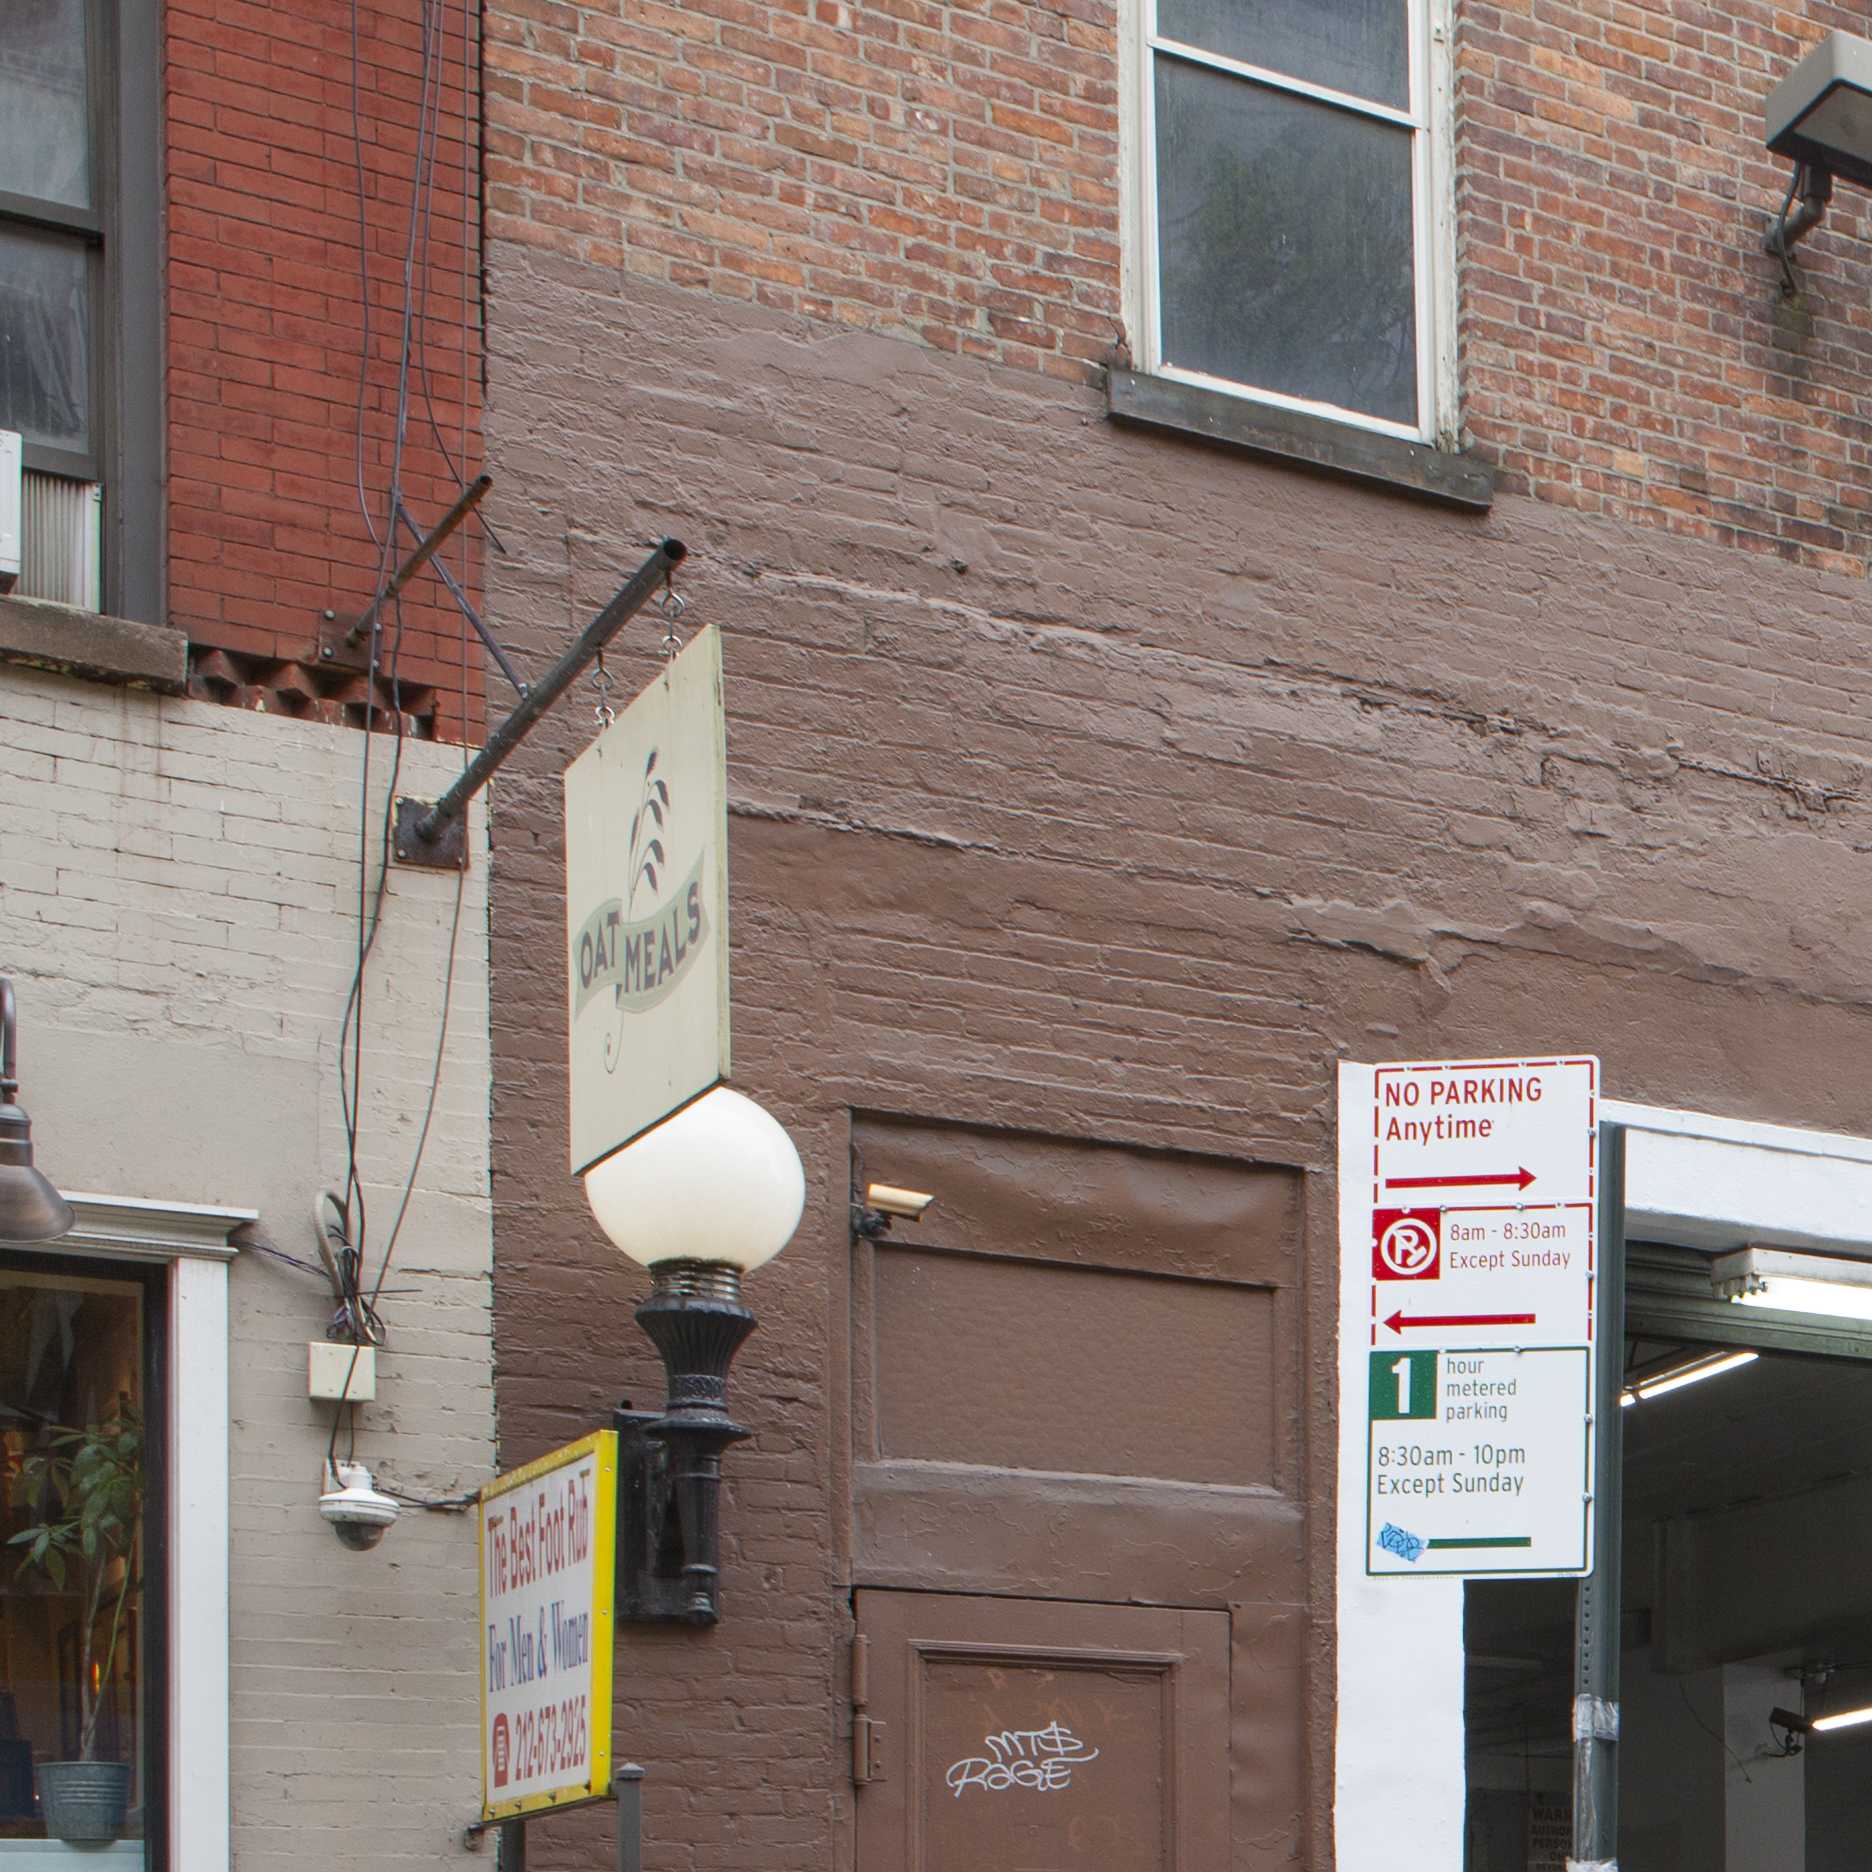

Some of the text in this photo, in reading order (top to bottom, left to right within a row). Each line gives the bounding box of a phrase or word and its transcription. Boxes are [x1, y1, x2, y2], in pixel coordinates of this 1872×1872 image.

[580, 881, 701, 993] OAT MEALS
[1384, 1076, 1542, 1108] NO PARKING
[1385, 1115, 1493, 1146] Anytime
[1449, 1222, 1486, 1241] 8am
[1503, 1221, 1566, 1240] 8:30am
[1449, 1249, 1571, 1271] Except Sunday
[1446, 1357, 1485, 1375] hour
[1391, 1357, 1412, 1415] 1
[1446, 1378, 1517, 1398] metered
[1445, 1402, 1508, 1423] parking
[1378, 1445, 1453, 1467] 8:30am
[1473, 1444, 1526, 1469] 10pm
[1377, 1472, 1525, 1498] Except Sunday
[487, 1470, 591, 1600] The Best Foot Rub
[487, 1599, 589, 1693] For Men & Women
[515, 1695, 588, 1782] 212-673-2925
